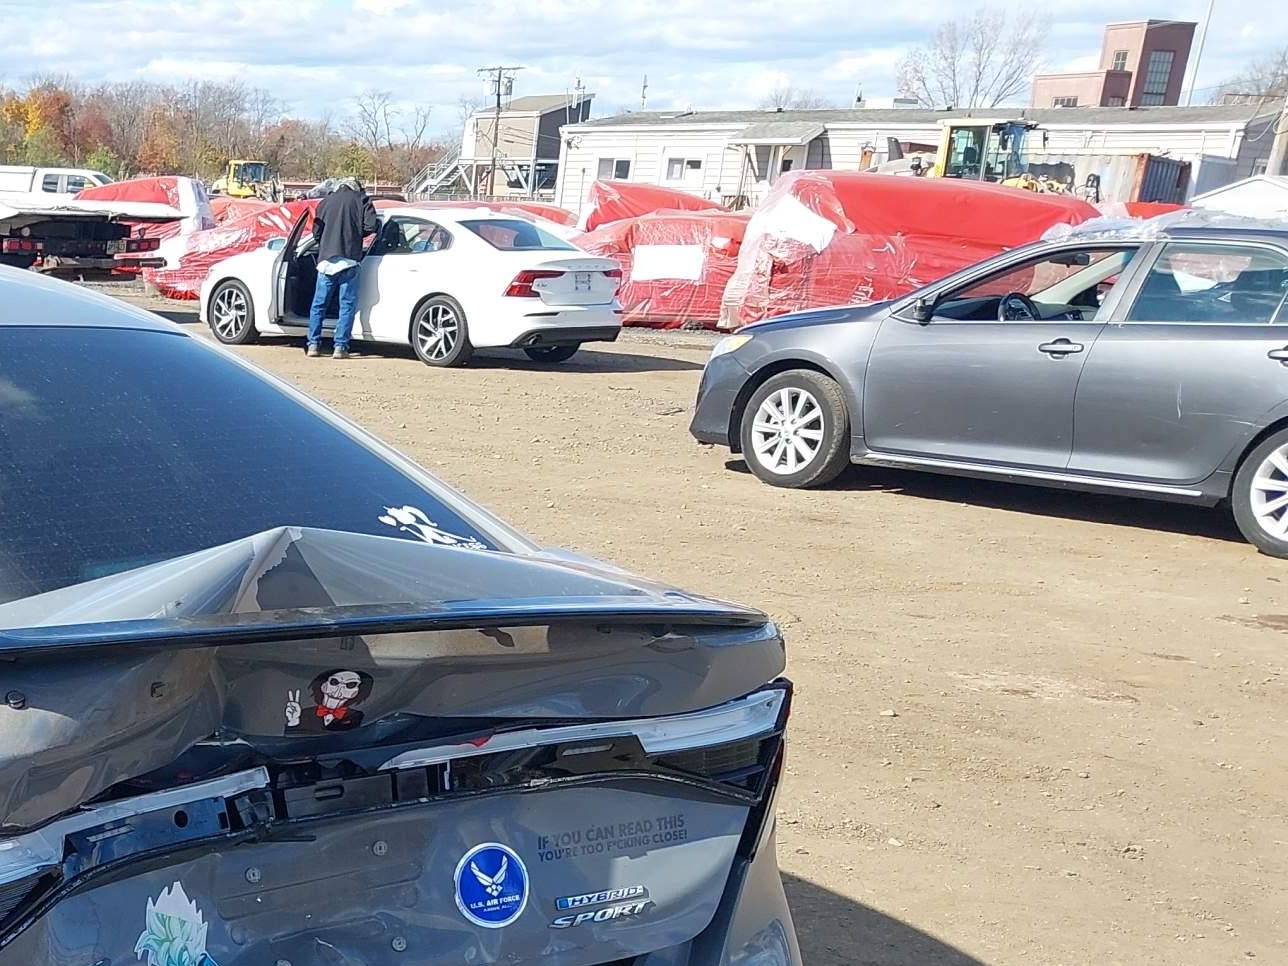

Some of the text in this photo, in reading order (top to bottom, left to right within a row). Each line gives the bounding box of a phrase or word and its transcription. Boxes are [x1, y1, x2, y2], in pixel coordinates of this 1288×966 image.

[537, 814, 686, 850] IF YOU CAN READ THIS
[538, 847, 579, 862] YOU'RE
[582, 843, 604, 855] TOO
[652, 828, 688, 843] CLOSE!
[470, 894, 520, 909] U.S. AIR FORCE
[570, 886, 641, 906] HYBRID
[548, 899, 653, 929] SPORT
